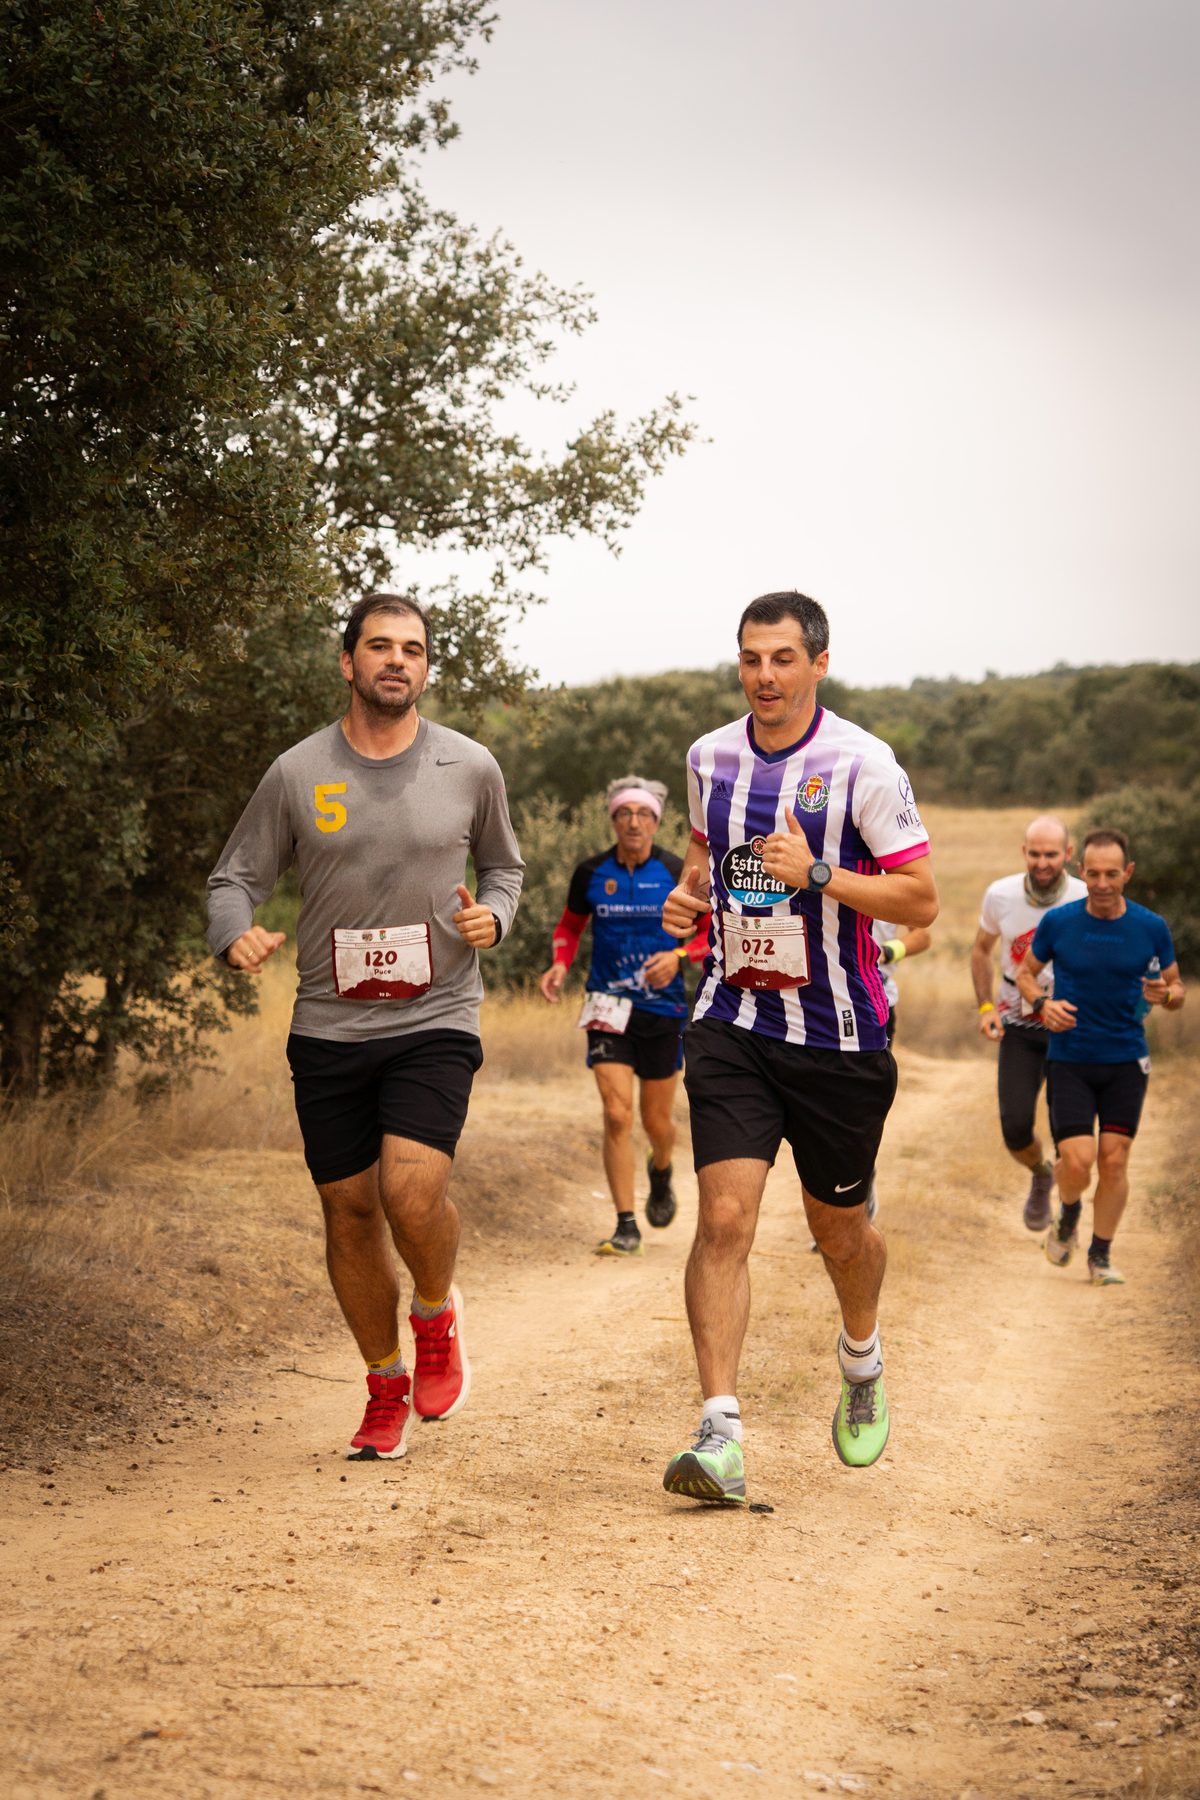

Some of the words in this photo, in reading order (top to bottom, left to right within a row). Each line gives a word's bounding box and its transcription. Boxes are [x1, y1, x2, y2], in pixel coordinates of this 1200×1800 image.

[314, 782, 347, 832] 5
[732, 871, 786, 892] Galicia
[741, 938, 776, 956] 072
[365, 950, 397, 967] 120
[748, 956, 768, 964] Puma
[374, 968, 392, 976] Puce
